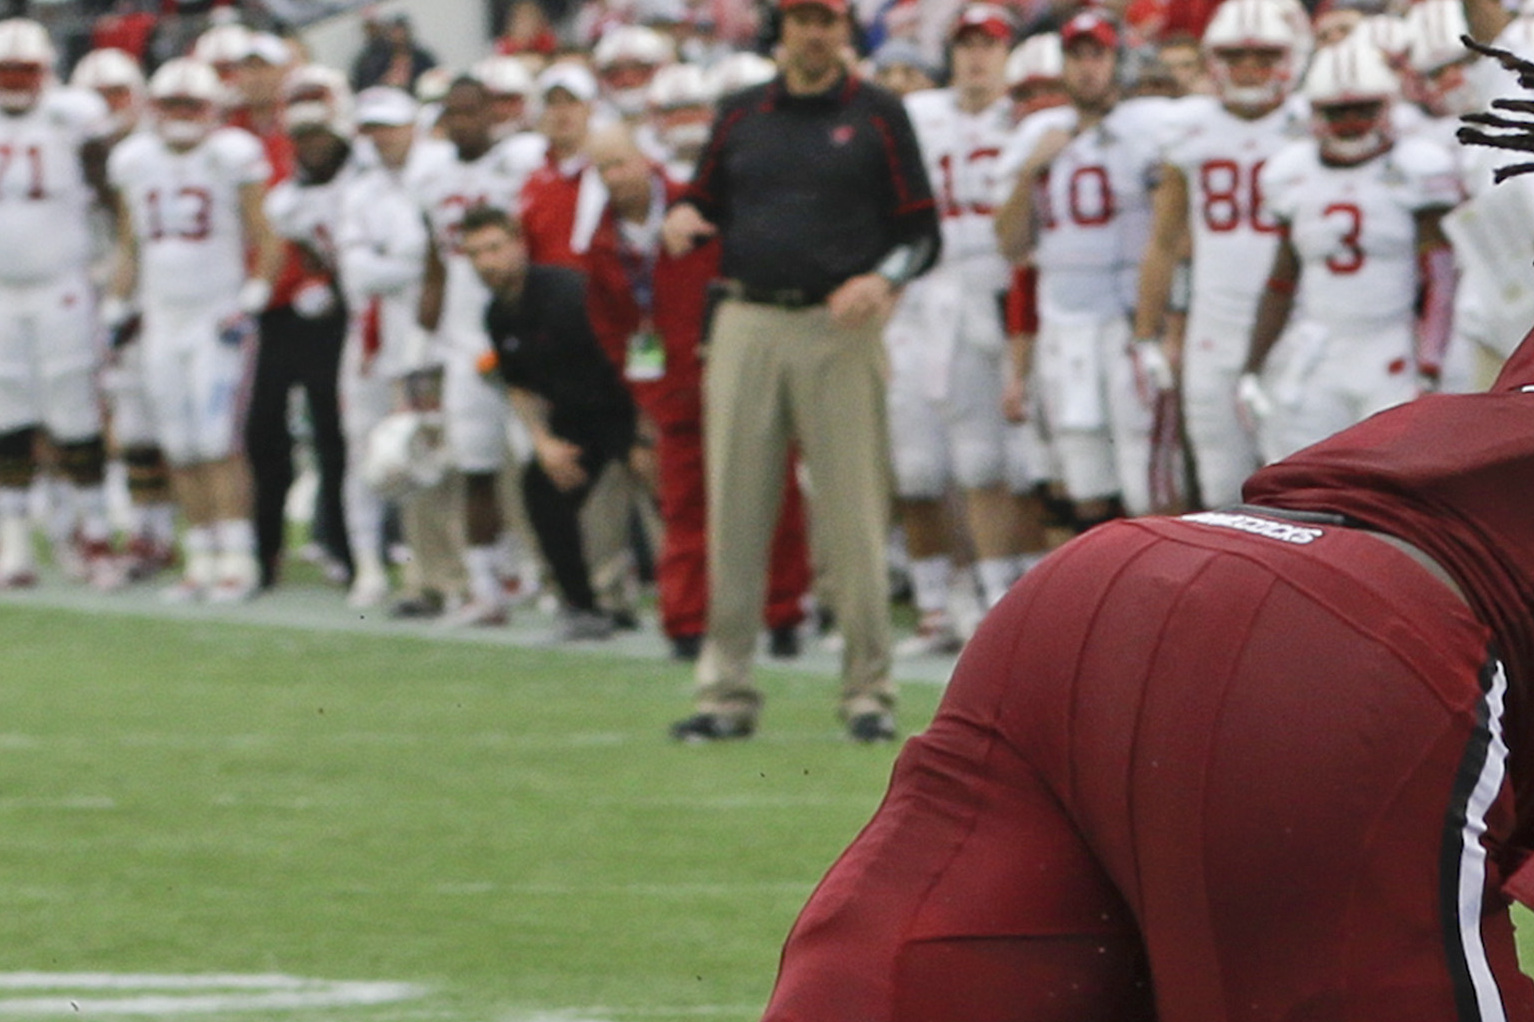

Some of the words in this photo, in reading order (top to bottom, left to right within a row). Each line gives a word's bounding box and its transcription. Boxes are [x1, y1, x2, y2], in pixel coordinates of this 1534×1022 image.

[147, 186, 213, 240] 13
[1037, 166, 1112, 227] 10
[1322, 203, 1364, 273] 3
